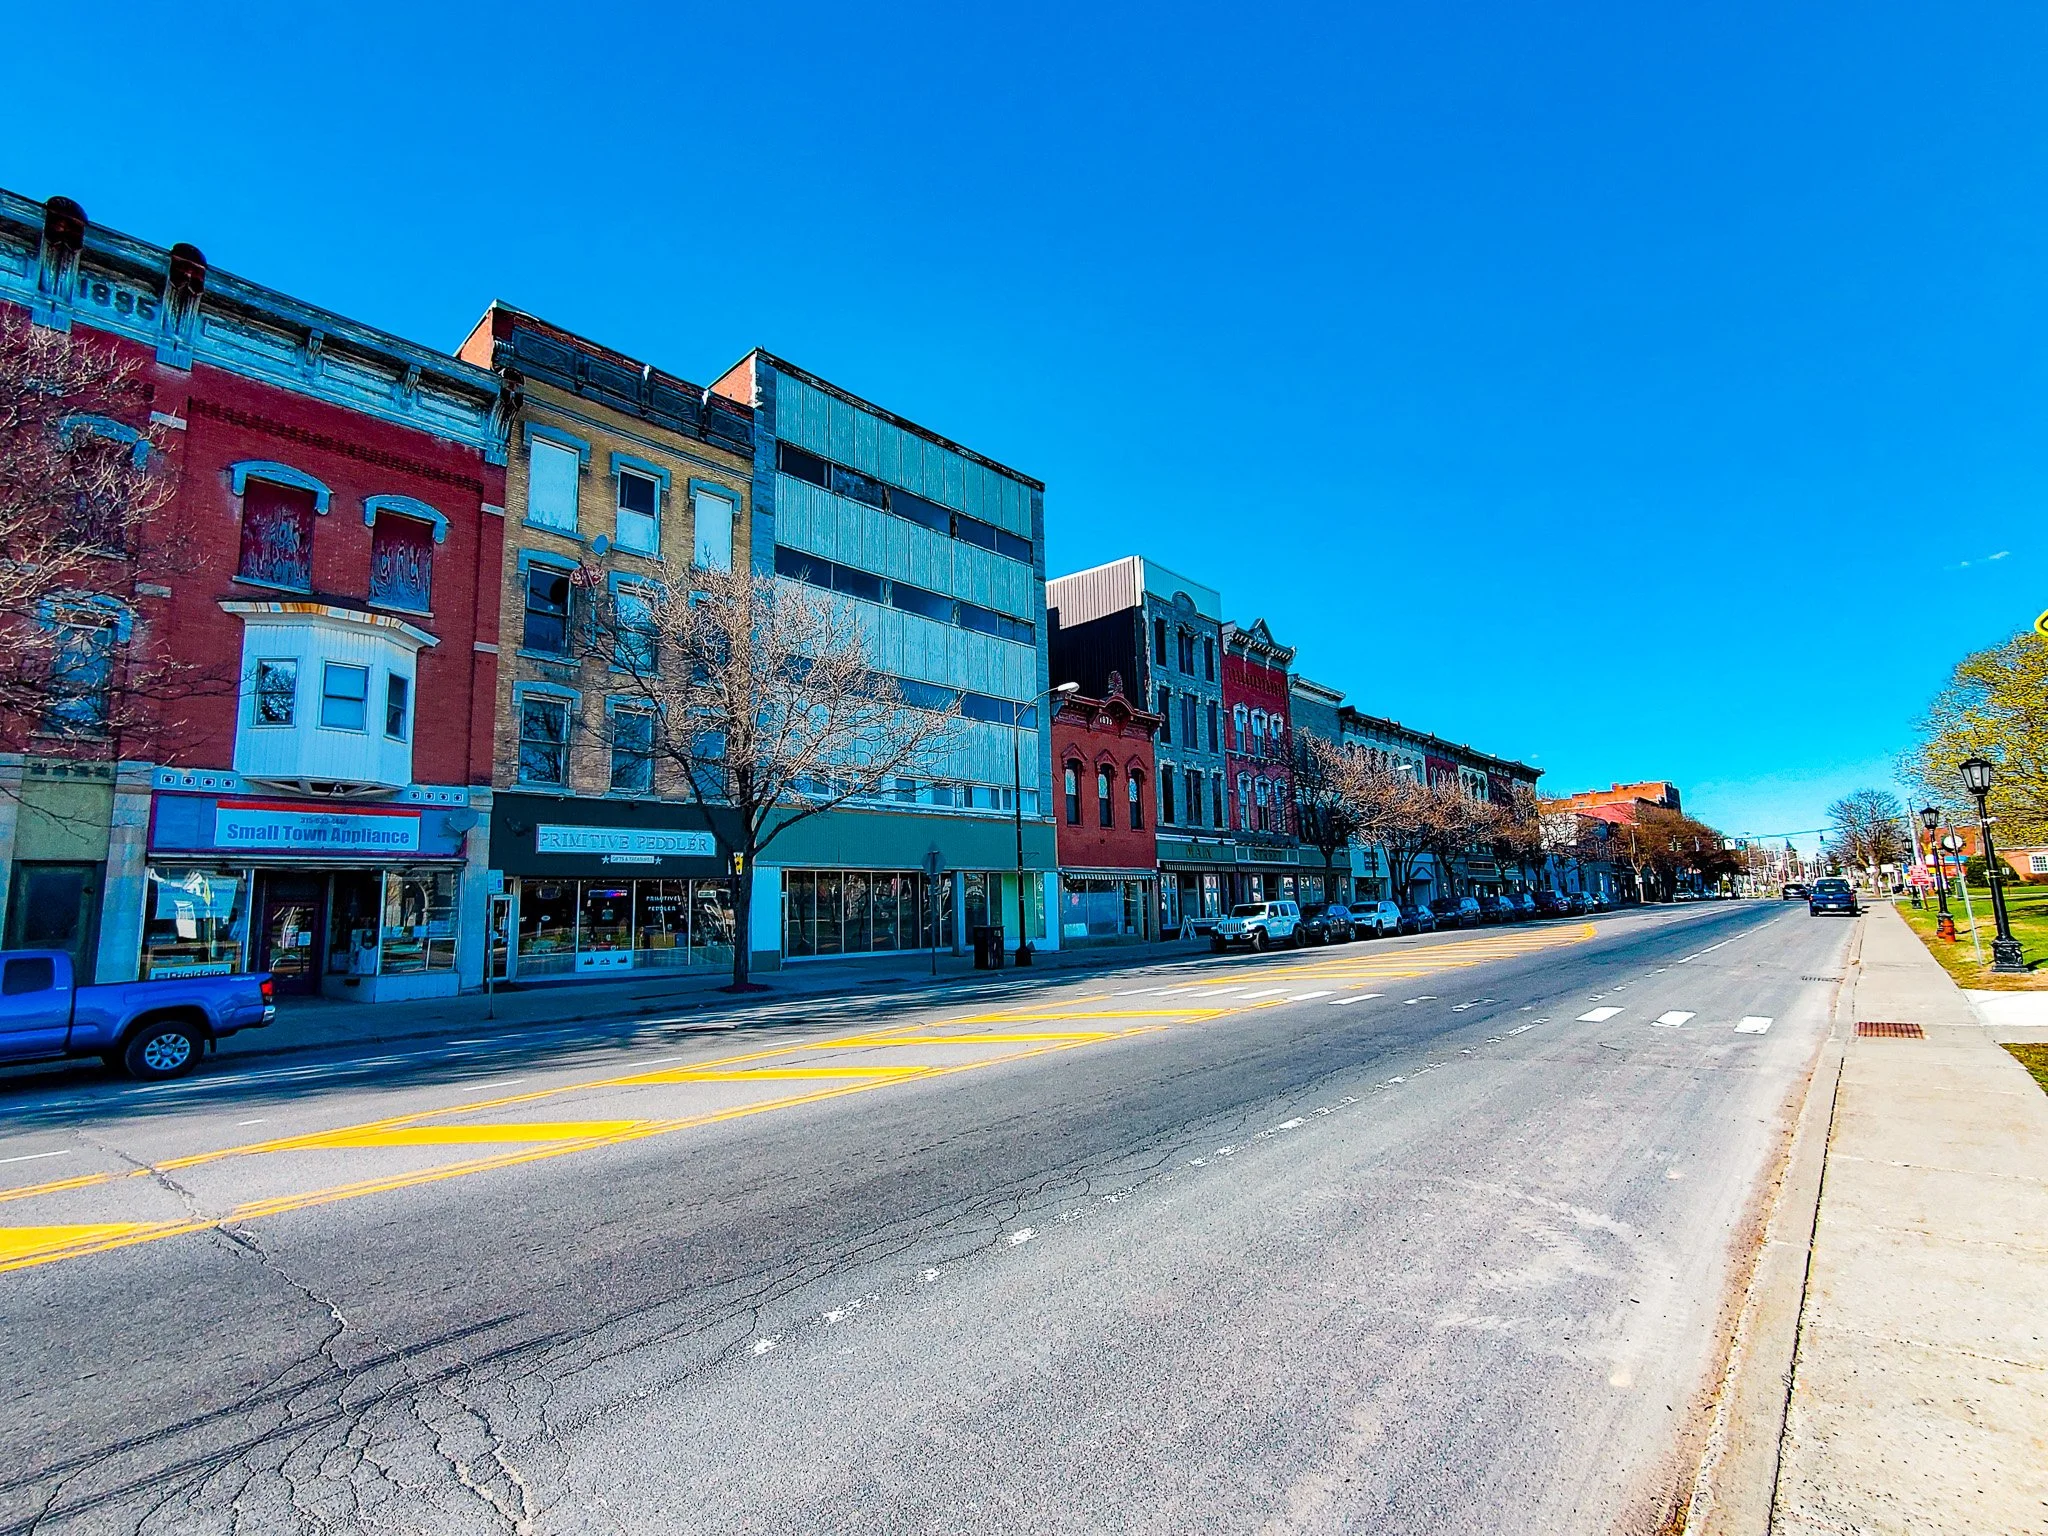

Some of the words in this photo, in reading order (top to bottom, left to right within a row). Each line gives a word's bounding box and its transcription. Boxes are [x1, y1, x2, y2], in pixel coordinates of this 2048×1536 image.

[227, 823, 279, 841] Small
[283, 825, 327, 842] Town
[330, 827, 410, 845] Appliance
[539, 832, 630, 850] PRIMITIVE
[636, 835, 708, 852] PEDDLER
